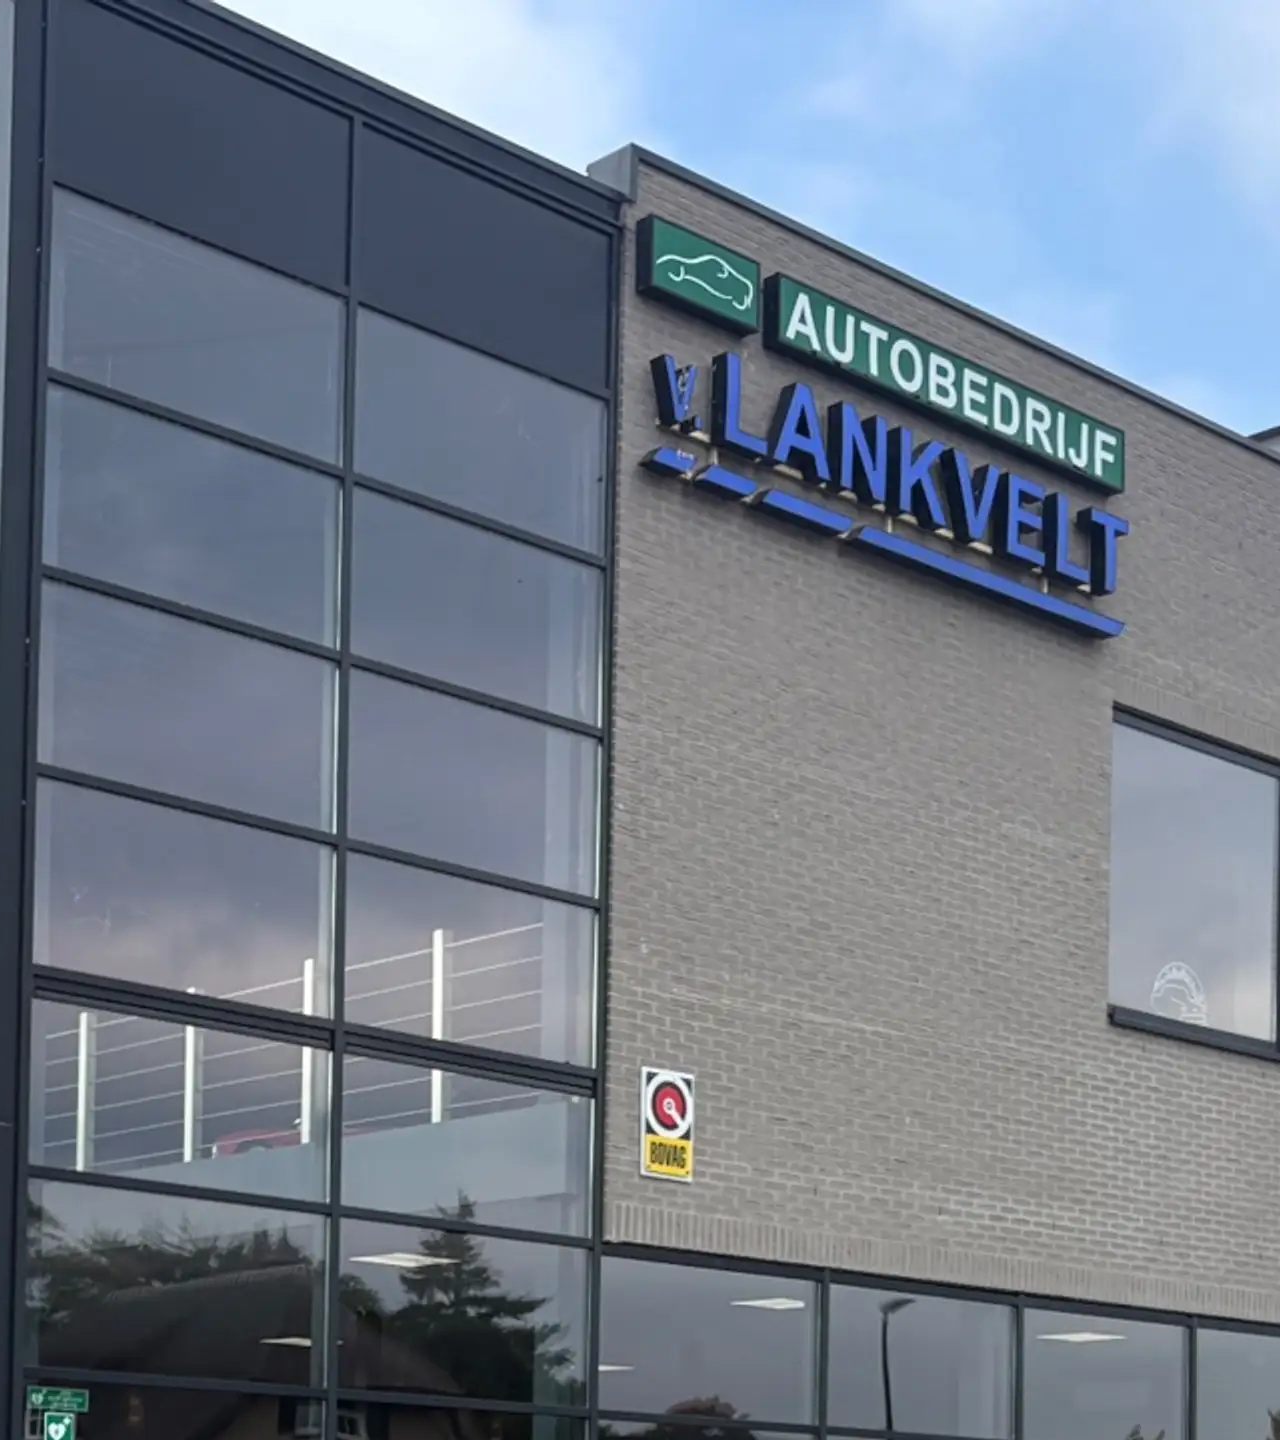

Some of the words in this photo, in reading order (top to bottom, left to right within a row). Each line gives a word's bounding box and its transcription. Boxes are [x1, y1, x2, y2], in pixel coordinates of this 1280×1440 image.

[719, 351, 1129, 596] LANKVELT
[785, 292, 1117, 479] AUTOBEDRIJF
[649, 1141, 687, 1169] BOVAG
